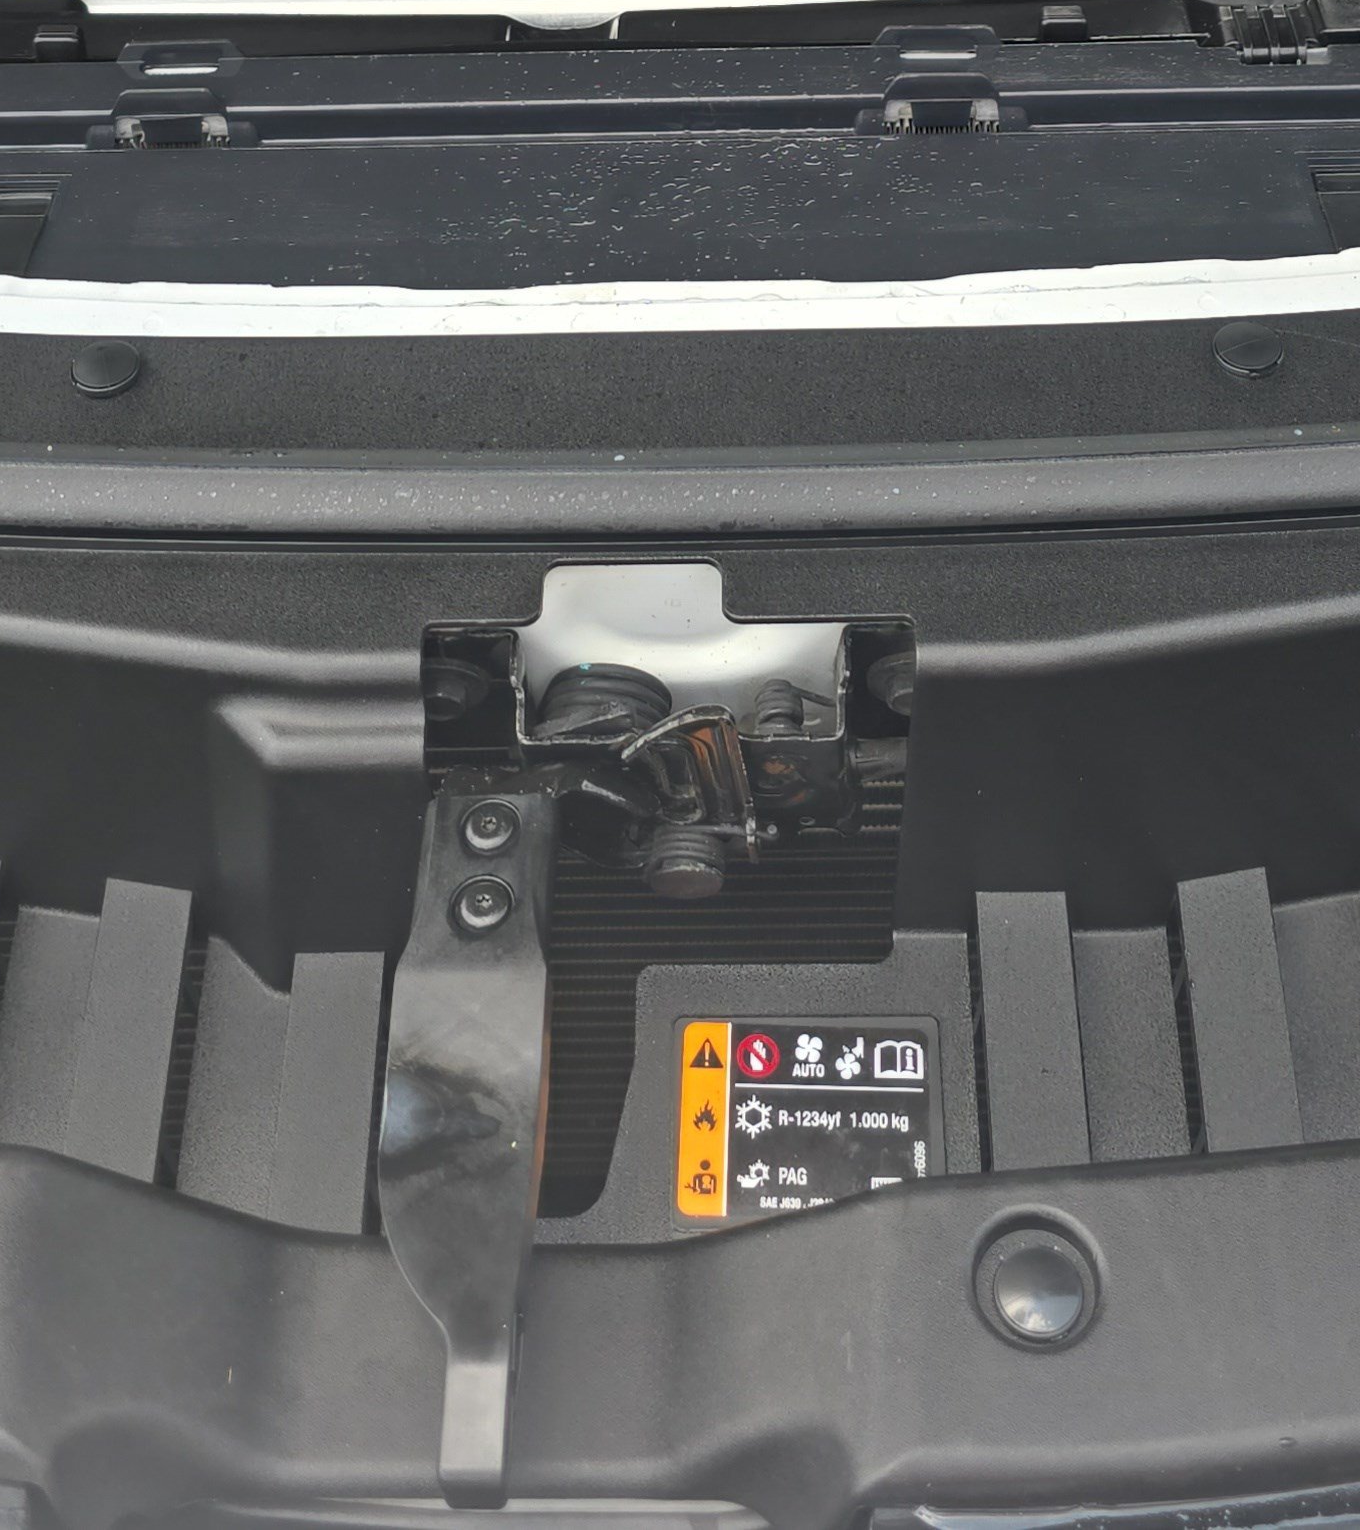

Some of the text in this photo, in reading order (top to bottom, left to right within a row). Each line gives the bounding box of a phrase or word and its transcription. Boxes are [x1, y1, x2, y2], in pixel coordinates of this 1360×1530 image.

[792, 1062, 824, 1077] AUTO
[779, 1110, 909, 1132] R-1234yf 1.000 kg
[779, 1167, 807, 1185] PAG
[760, 1196, 778, 1209] SAE
